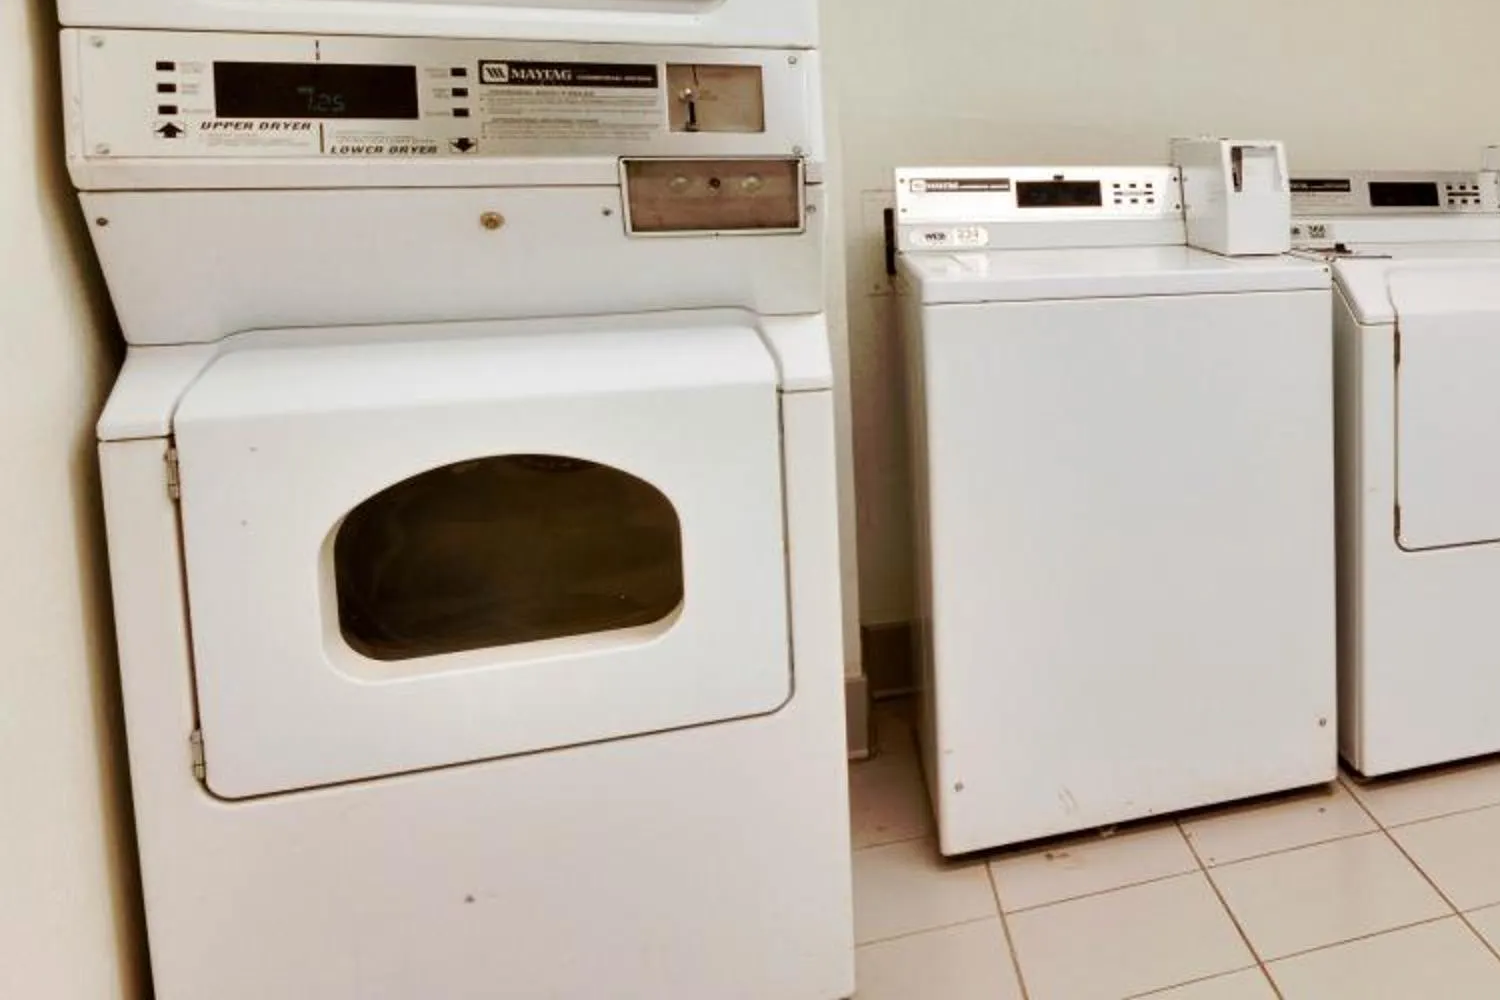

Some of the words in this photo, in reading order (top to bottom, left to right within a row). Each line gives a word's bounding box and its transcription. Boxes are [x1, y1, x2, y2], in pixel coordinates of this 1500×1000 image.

[511, 68, 572, 81] MAYTAG
[201, 121, 254, 130] UPPER
[259, 121, 311, 131] DRYER
[331, 144, 383, 154] LOWER
[388, 144, 437, 154] DRYER
